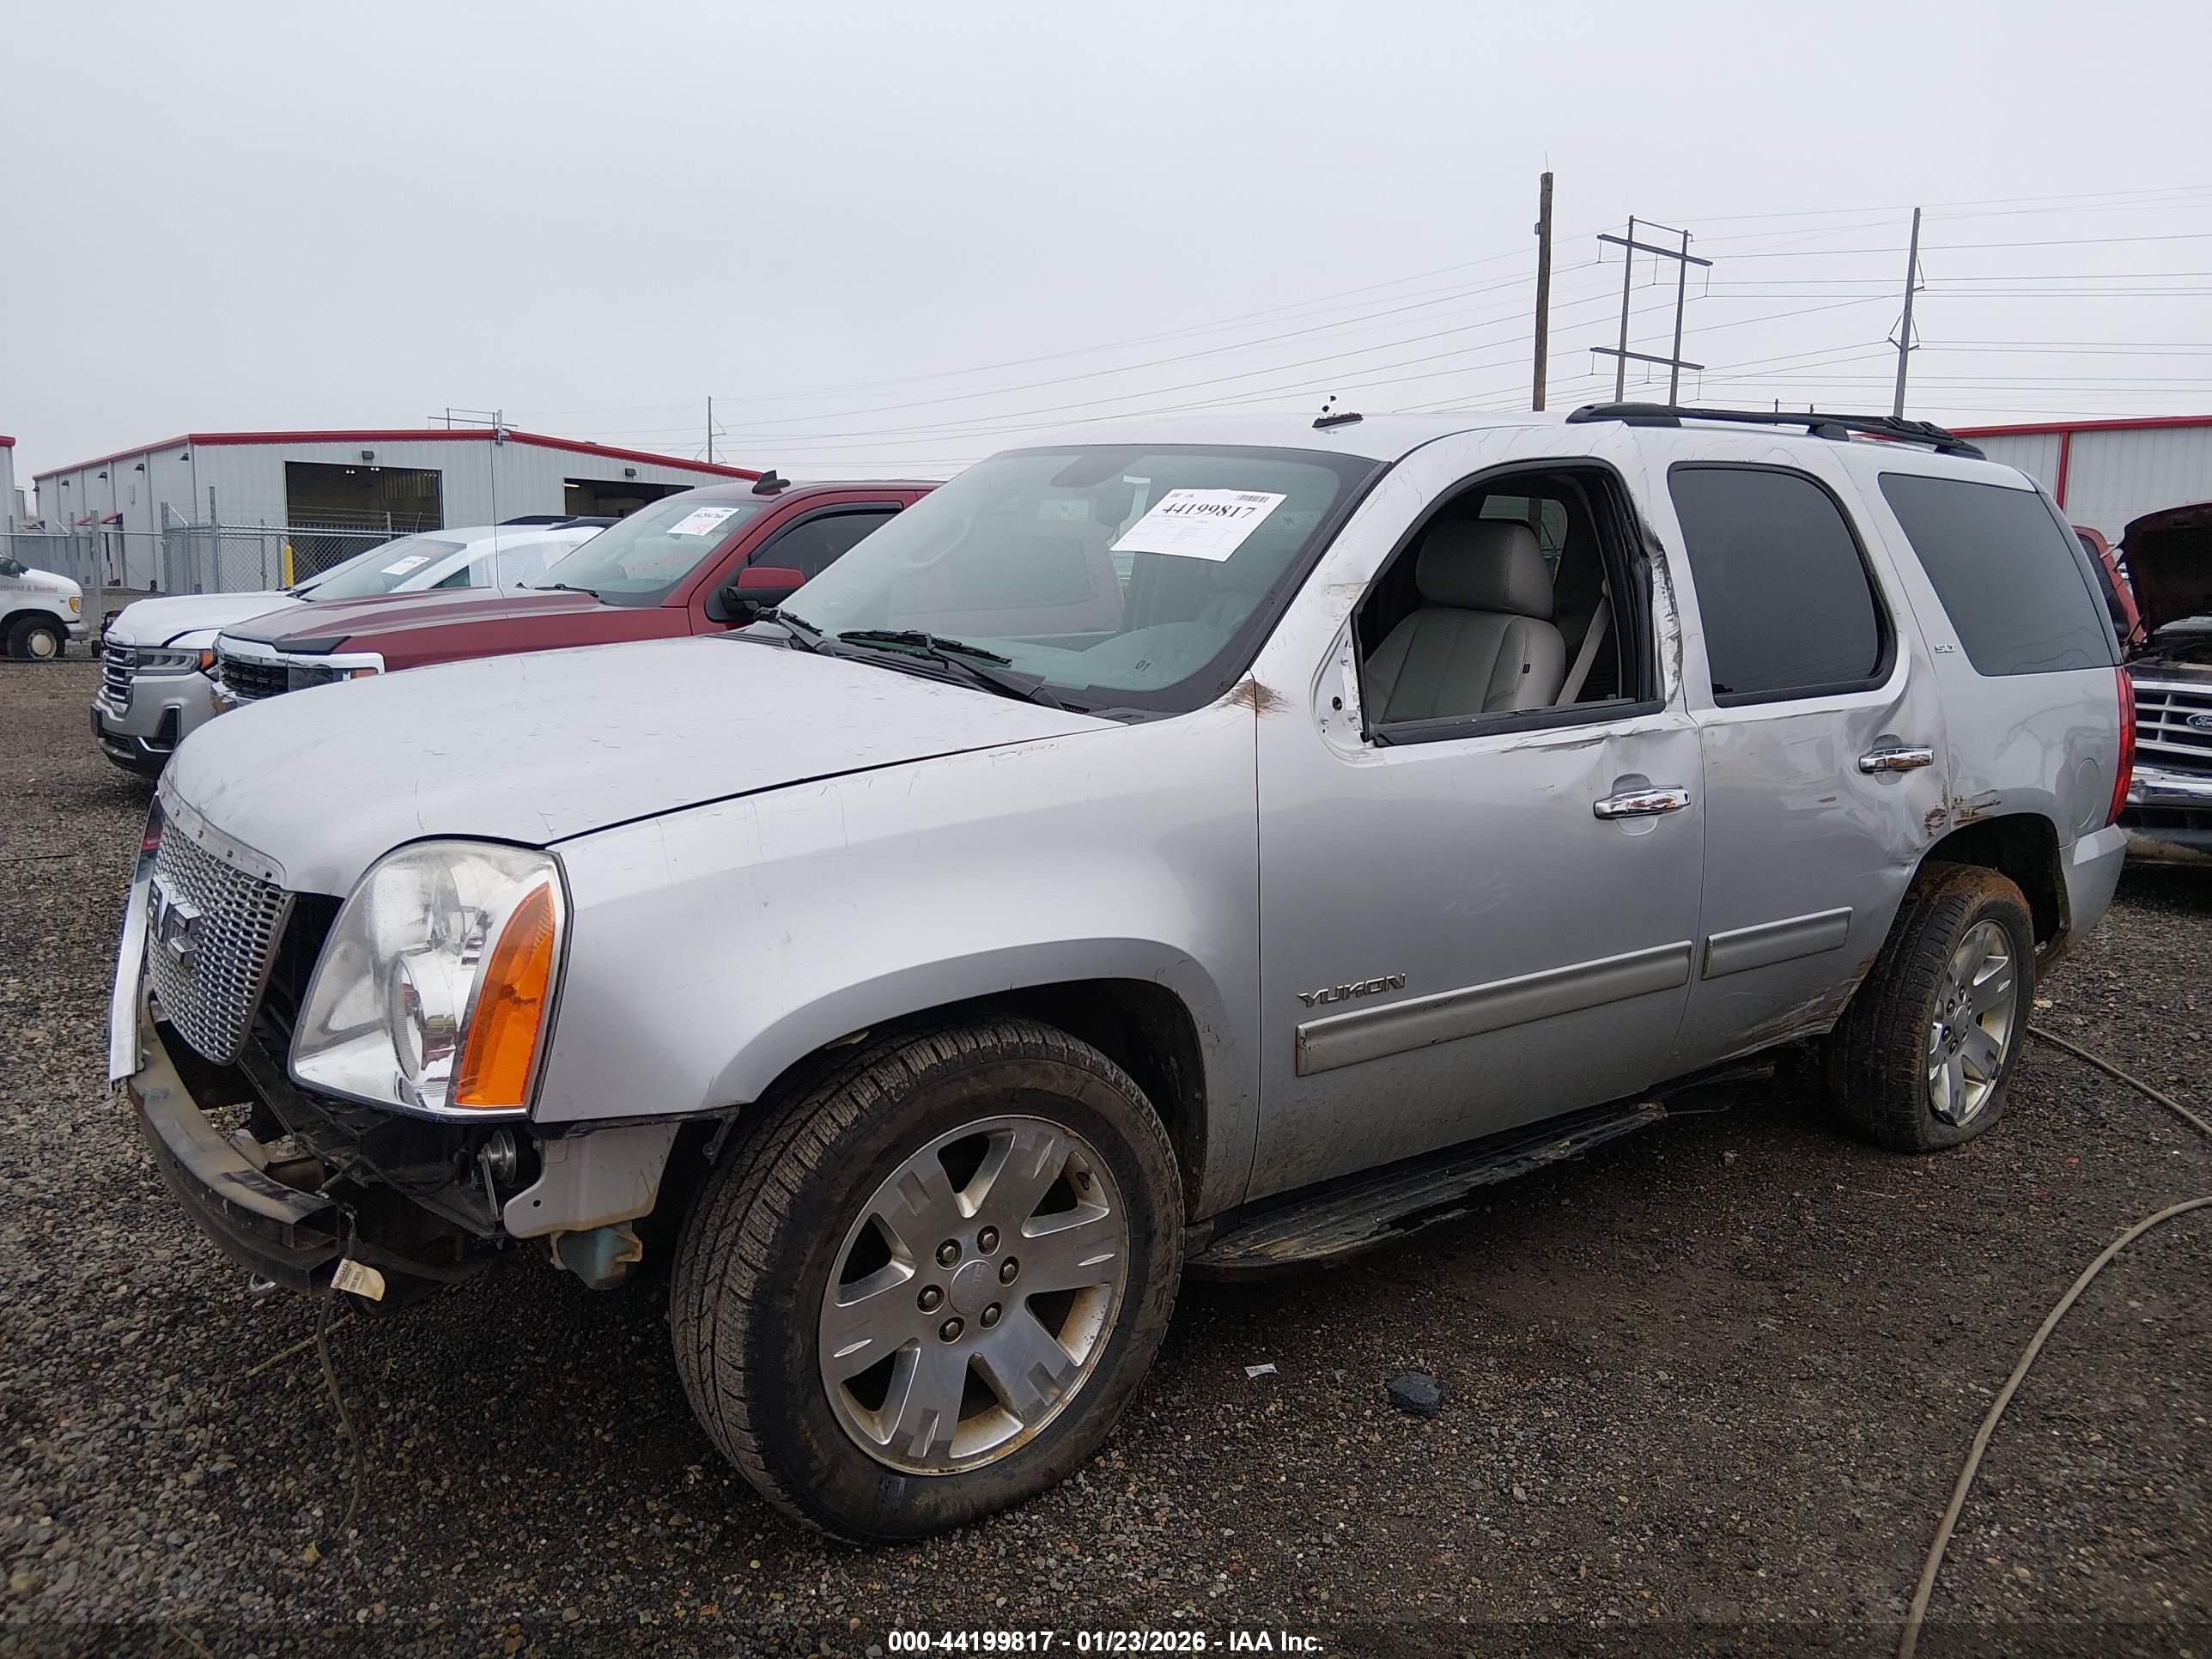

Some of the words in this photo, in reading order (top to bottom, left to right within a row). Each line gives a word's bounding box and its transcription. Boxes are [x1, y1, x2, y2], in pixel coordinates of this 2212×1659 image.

[1163, 501, 1258, 519] 44199817
[1935, 643, 1957, 653] SLT
[1297, 972, 1407, 1008] YUKON
